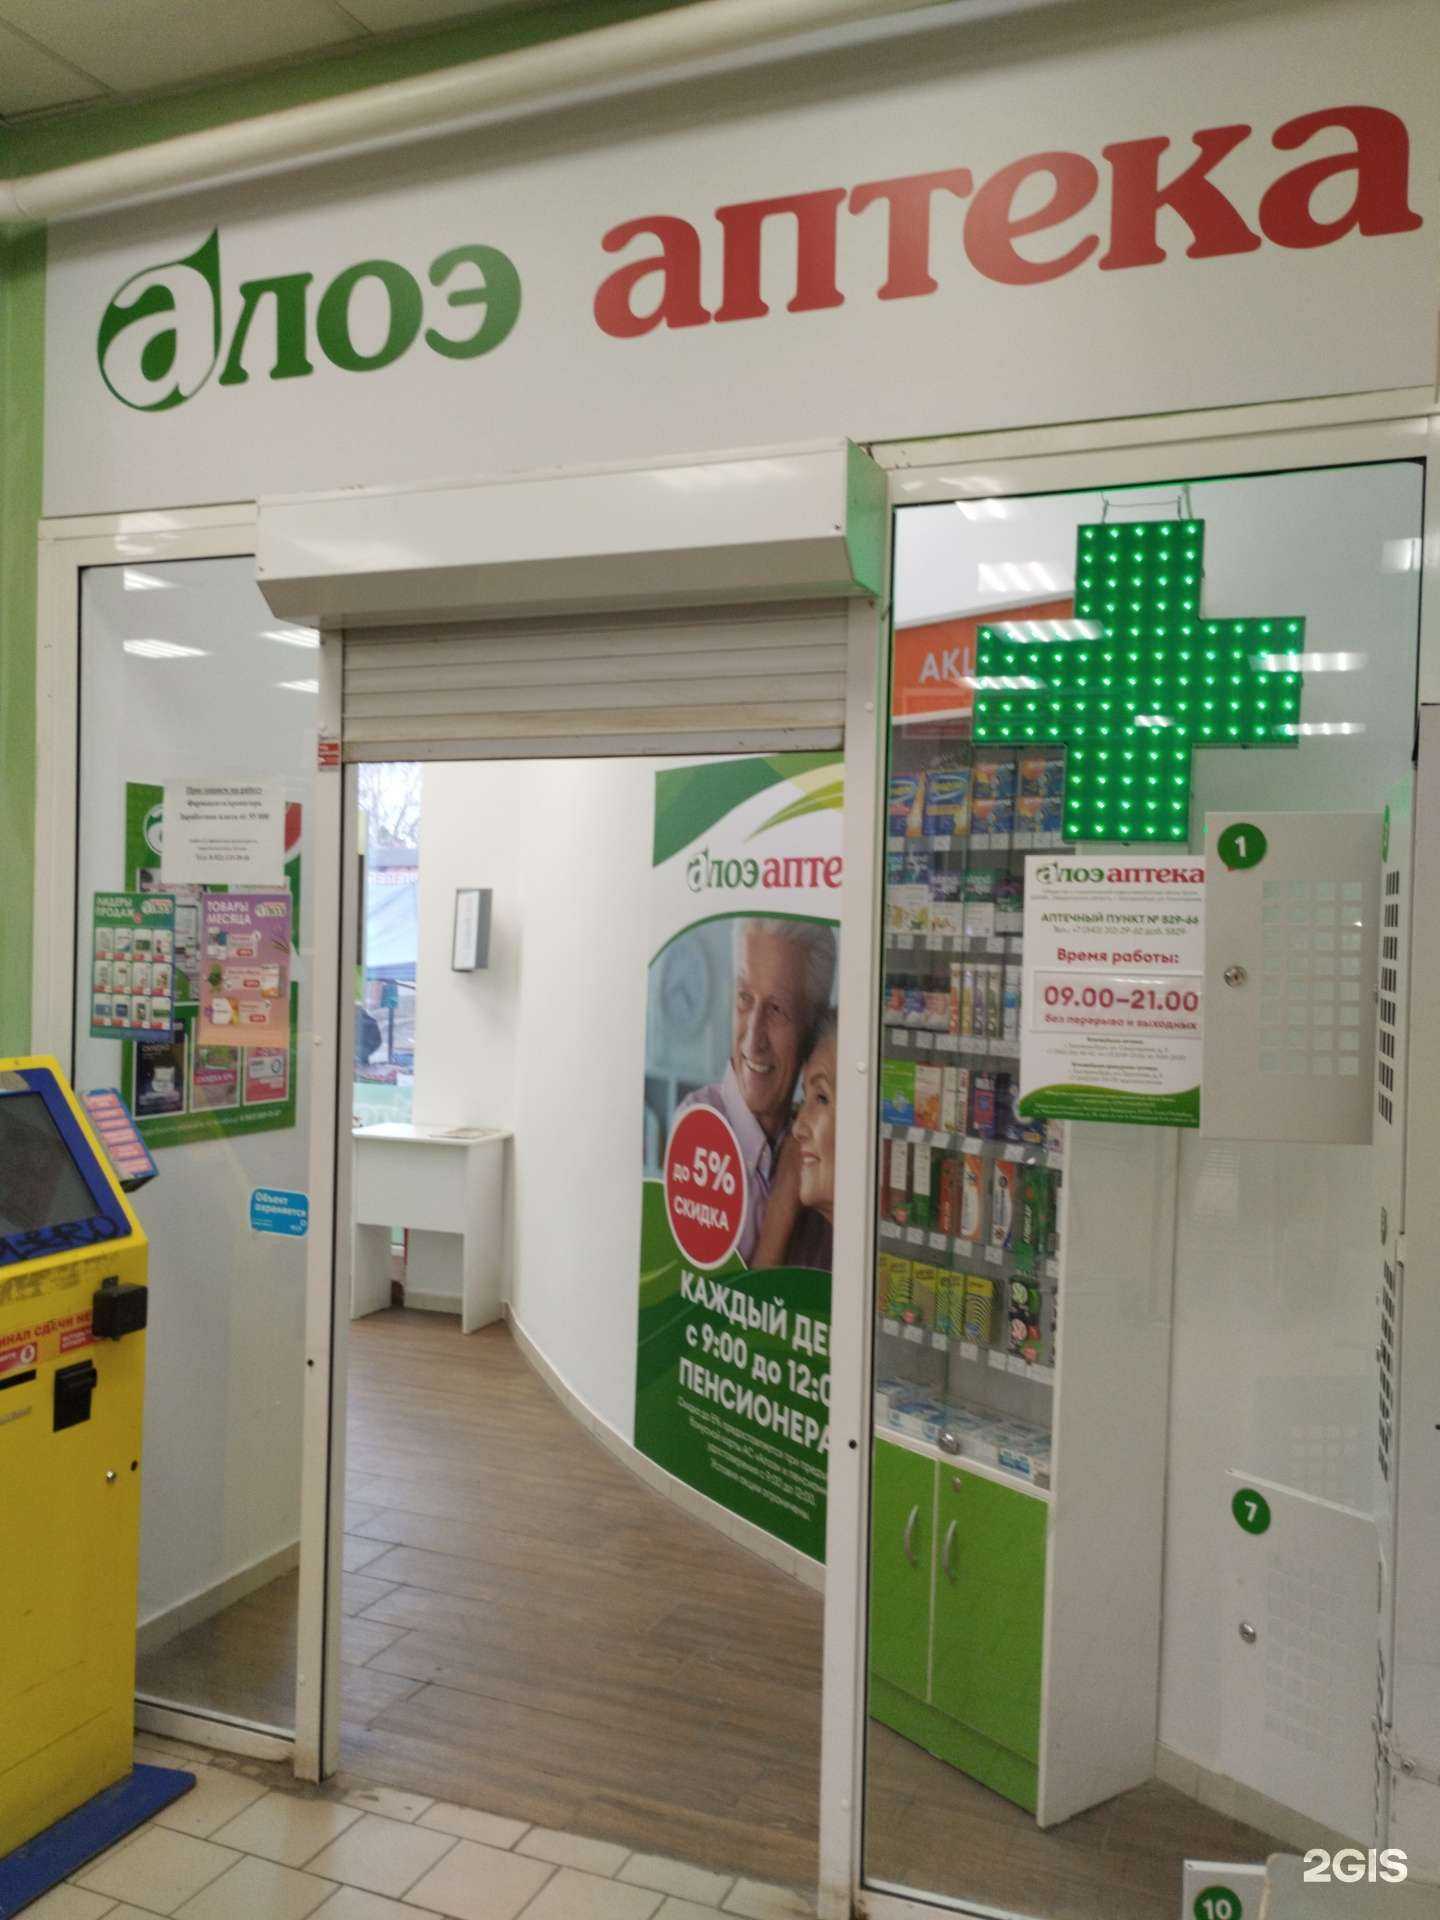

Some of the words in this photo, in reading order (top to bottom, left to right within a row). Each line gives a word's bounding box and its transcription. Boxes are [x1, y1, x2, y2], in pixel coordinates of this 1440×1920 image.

[593, 105, 1424, 338] аптека
[1234, 836, 1248, 859] 1
[1107, 866, 1206, 884] аптека
[1041, 911, 1104, 923] АПТЕЧНЫЙ
[1106, 913, 1145, 924] ПУНКТ
[1057, 948, 1107, 964] Время
[1112, 950, 1180, 965] работы:
[693, 1146, 736, 1196] 5%
[673, 1195, 729, 1232] СКИДКА
[680, 1269, 788, 1341] КАЖДЫЙ
[791, 1313, 832, 1358] ДЕ
[701, 1323, 747, 1369] 9:00
[752, 1353, 782, 1386] до
[1244, 1500, 1259, 1523] 7
[1203, 1899, 1232, 1920] 10
